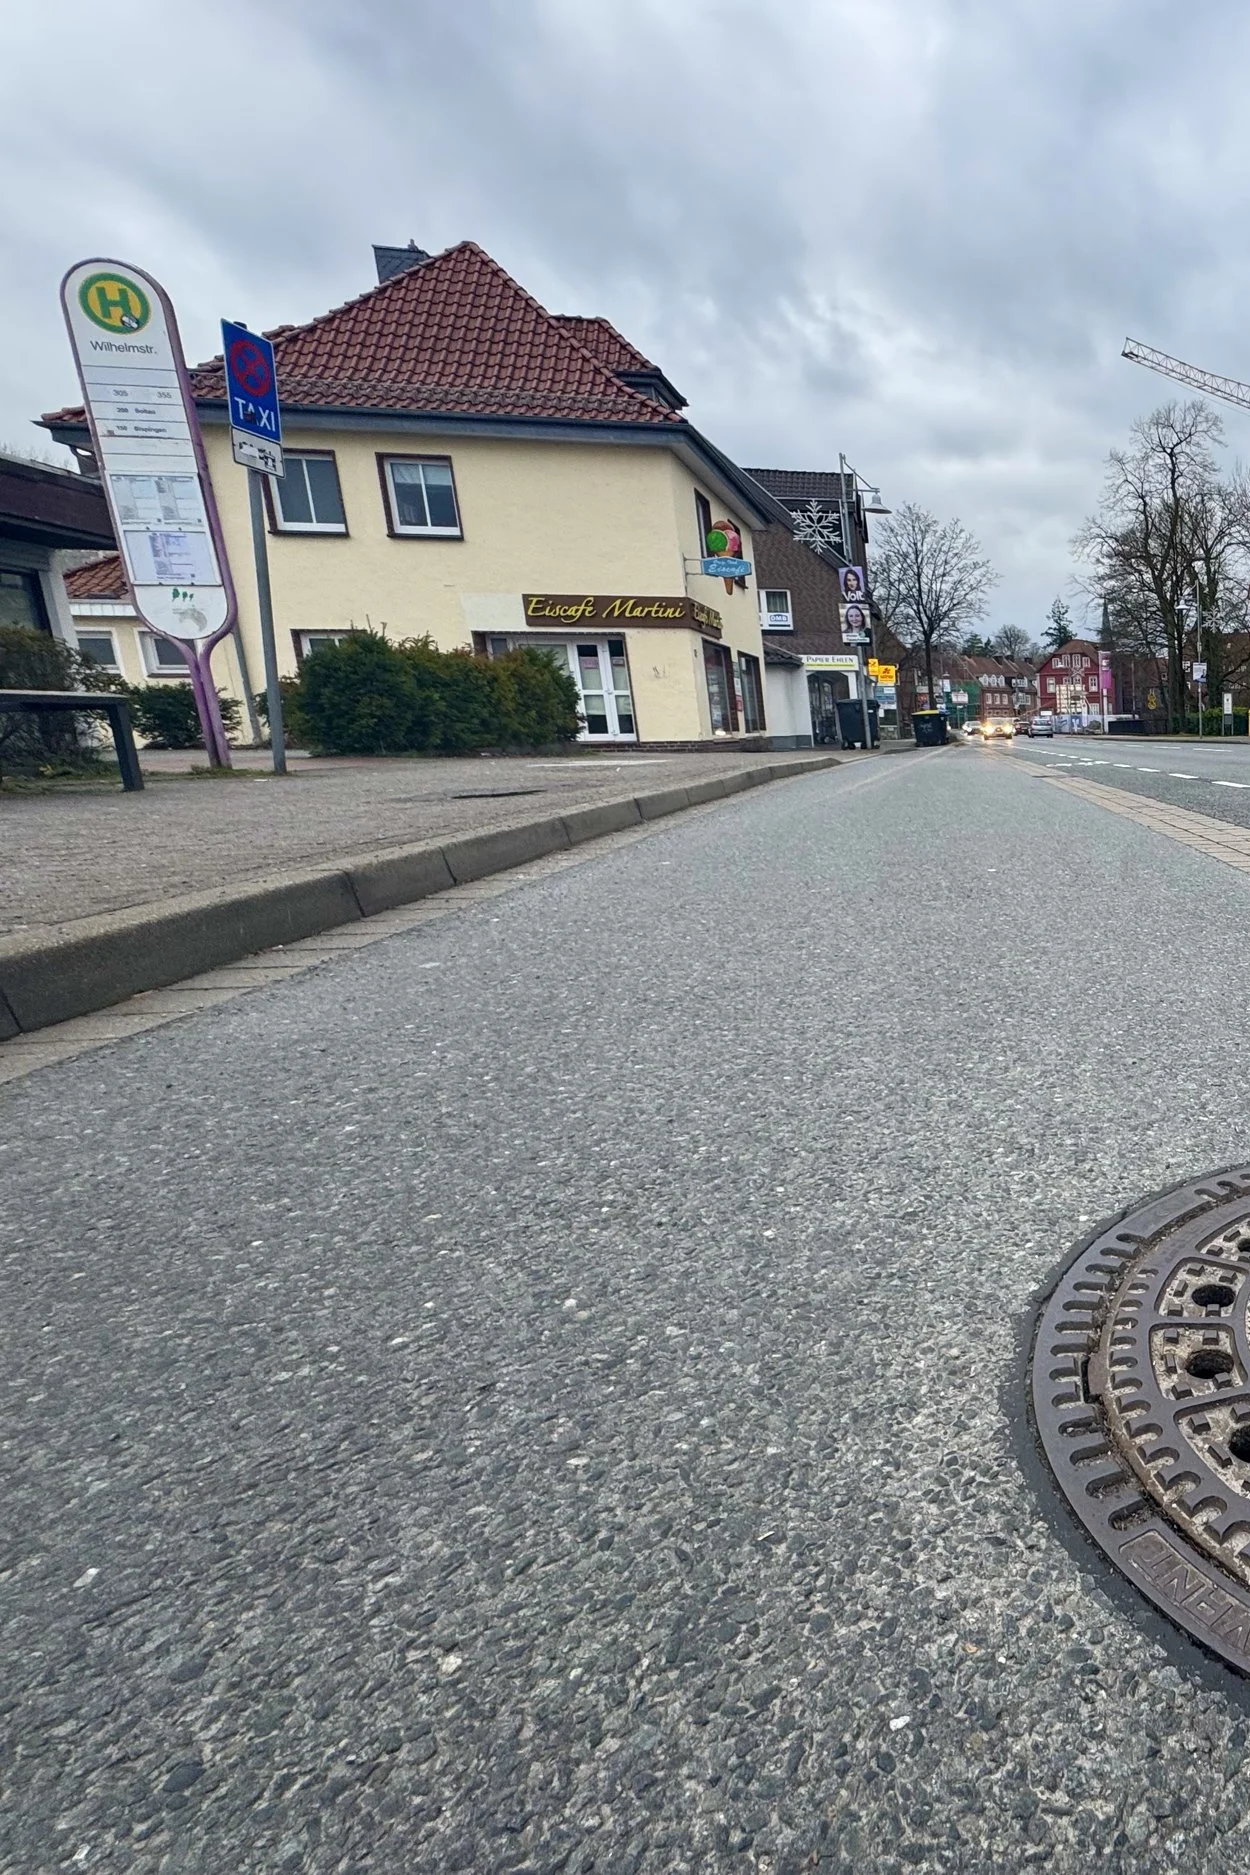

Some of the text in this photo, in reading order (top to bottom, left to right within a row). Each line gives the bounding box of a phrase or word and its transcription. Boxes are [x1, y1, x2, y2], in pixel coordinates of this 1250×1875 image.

[90, 340, 157, 354] Wilhelmstr.
[842, 591, 865, 602] Volt
[602, 599, 686, 619] Martini
